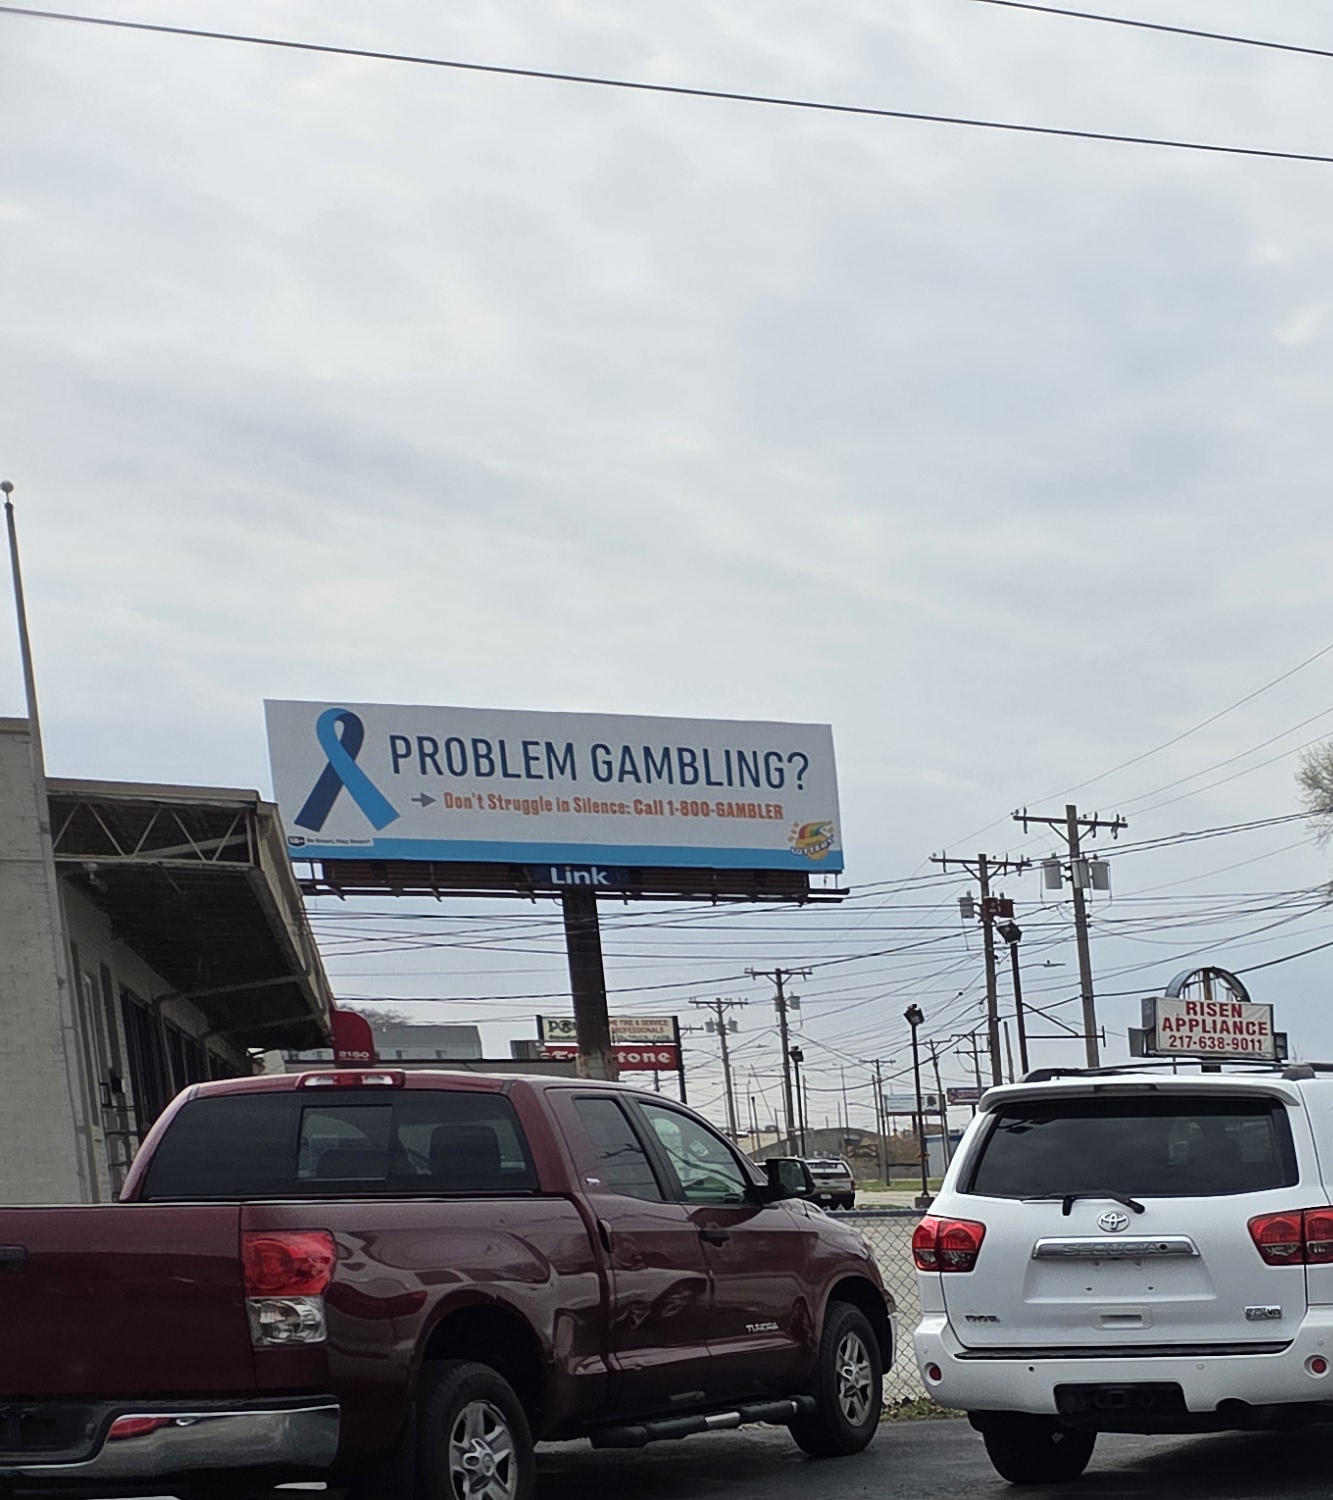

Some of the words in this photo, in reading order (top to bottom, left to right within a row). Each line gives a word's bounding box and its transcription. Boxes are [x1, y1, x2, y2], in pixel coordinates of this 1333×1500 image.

[389, 734, 578, 782] PROBLEM
[590, 743, 809, 791] GAMBLING?
[443, 791, 485, 811] Don't
[487, 793, 553, 815] Struggle
[556, 796, 570, 813] in
[573, 796, 631, 815] Silence:
[633, 798, 664, 816] Call
[666, 800, 784, 820] 1-800-GAMBLER
[550, 865, 610, 887] Link
[1186, 1001, 1243, 1018] RISEN
[1162, 1017, 1269, 1036] APPLIANCE
[1168, 1034, 1263, 1051] 217-638-9011
